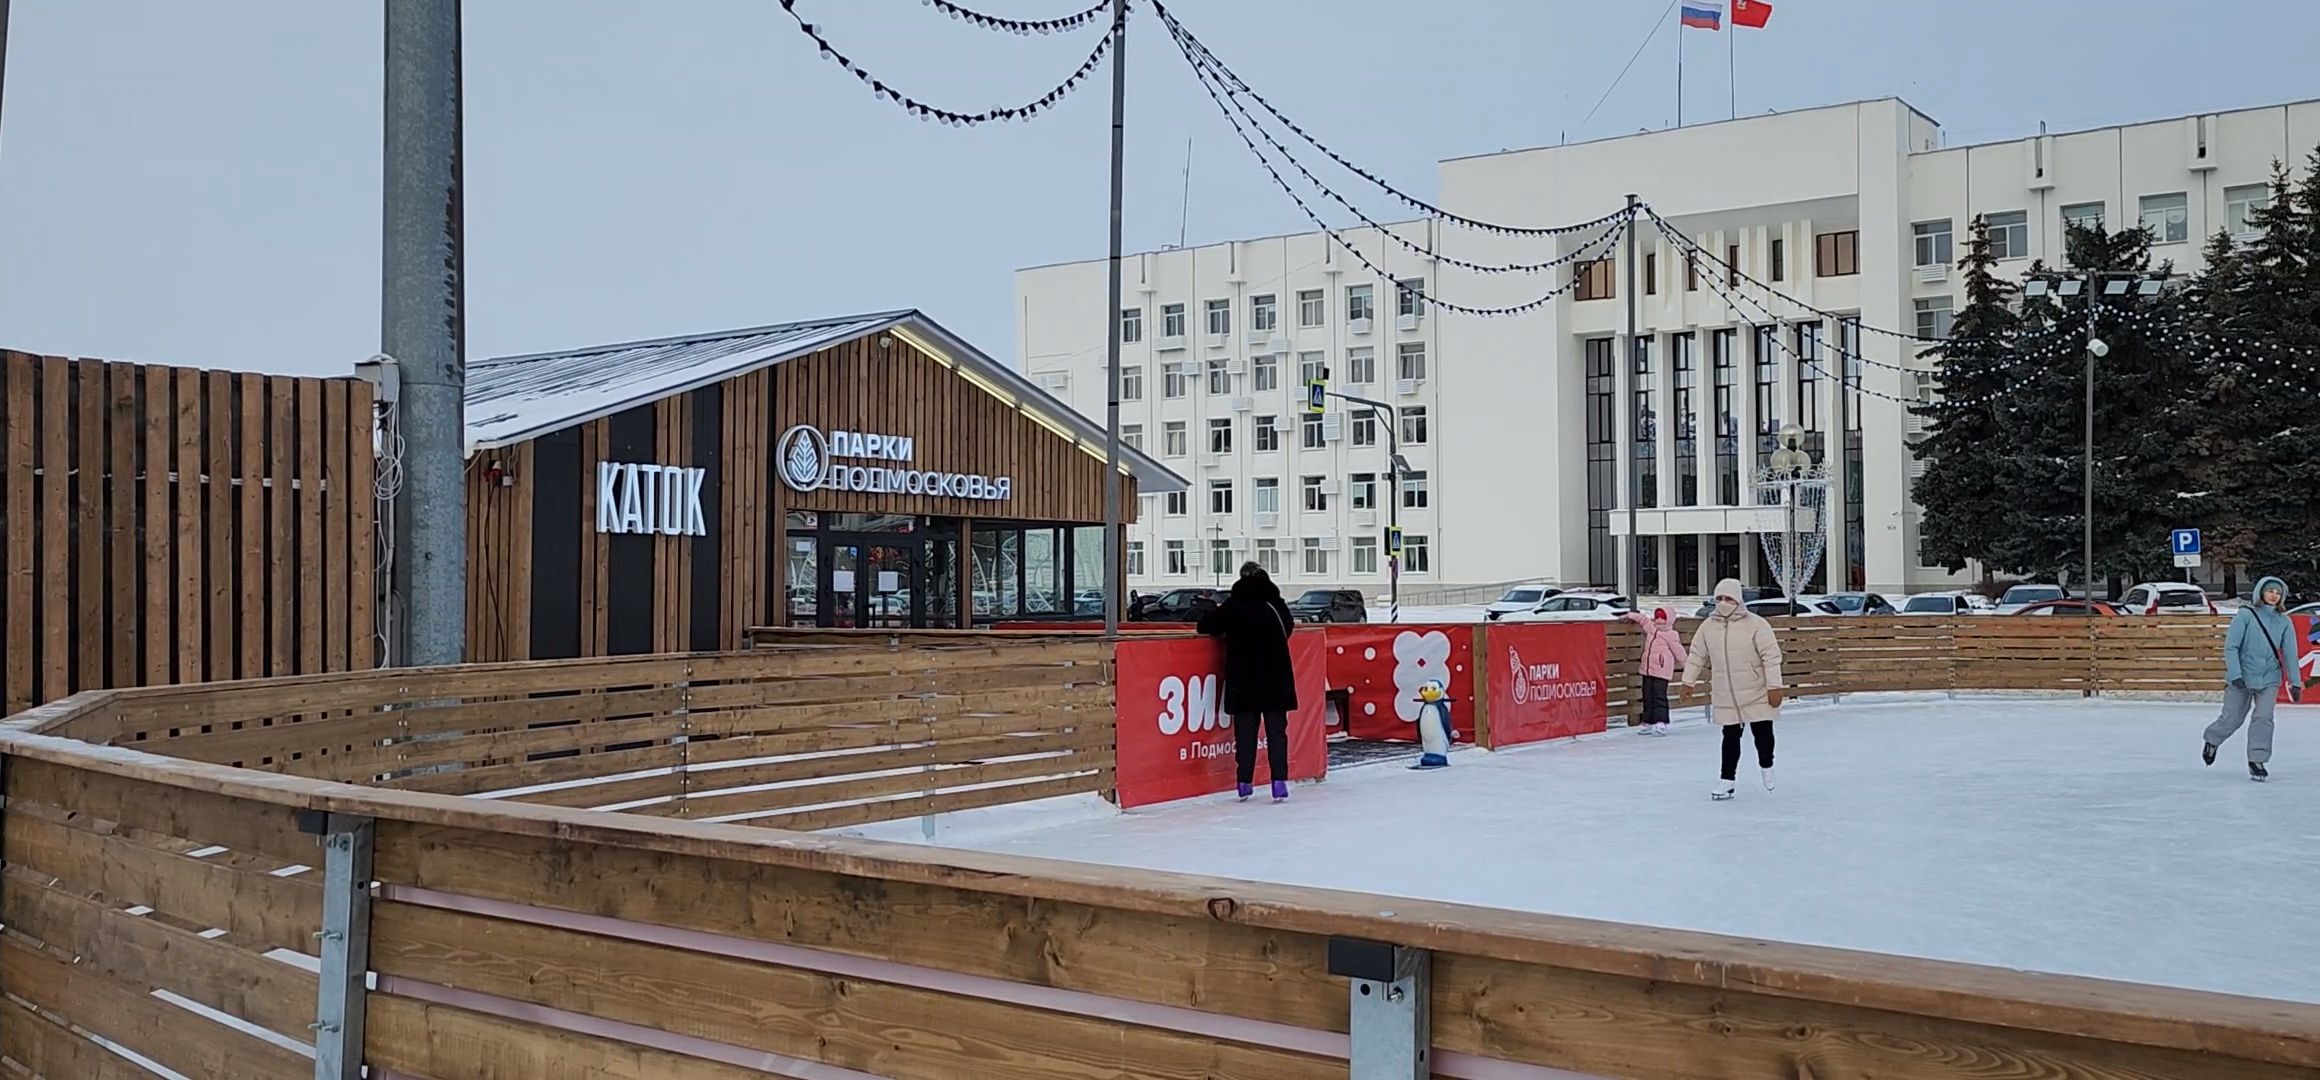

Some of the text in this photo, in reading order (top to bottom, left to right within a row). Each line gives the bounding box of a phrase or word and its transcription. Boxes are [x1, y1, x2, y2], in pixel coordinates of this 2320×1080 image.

[831, 431, 912, 461] ПАРКИ
[831, 465, 1010, 500] ПОДМОСКОВЬЯ
[597, 461, 706, 536] КАТОК
[2179, 533, 2193, 551] P
[1530, 663, 1560, 680] ПАРКИ
[1530, 682, 1597, 700] ПОДМОСКОВЬЯ
[1158, 674, 1232, 735] ЗИ
[1180, 737, 1268, 760] в Подмосье
